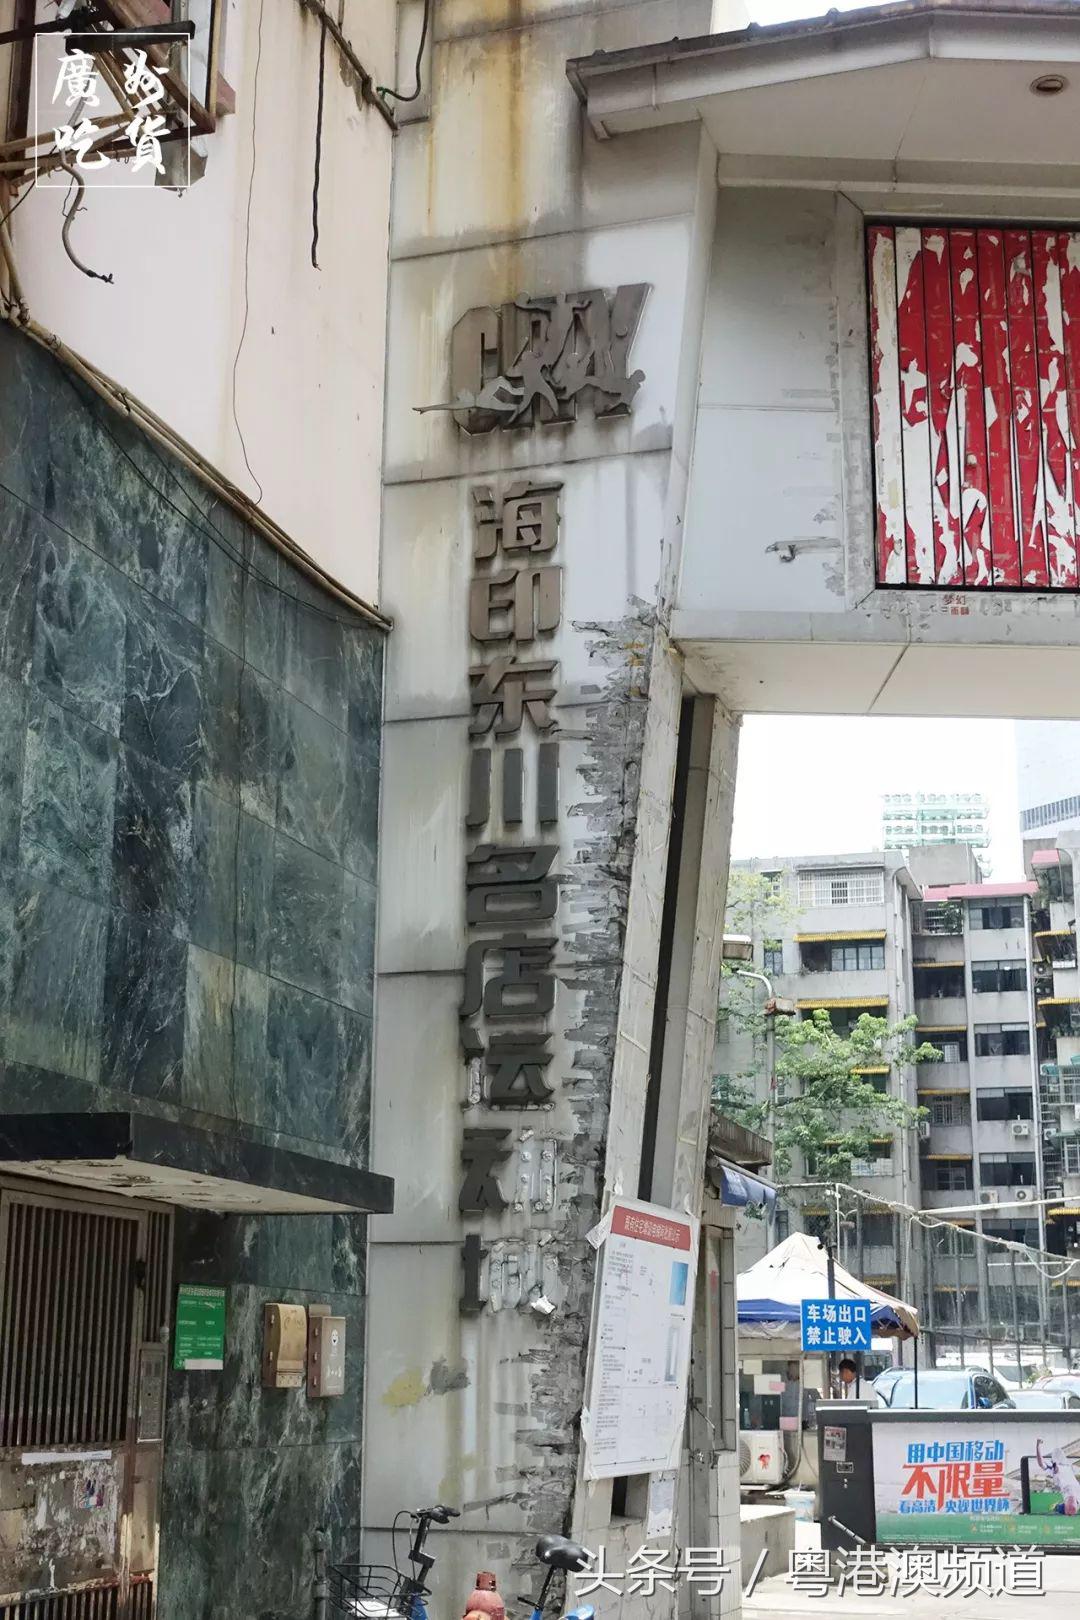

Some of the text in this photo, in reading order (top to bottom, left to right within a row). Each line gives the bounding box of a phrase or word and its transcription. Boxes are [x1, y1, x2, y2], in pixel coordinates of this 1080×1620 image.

[807, 1303, 866, 1323] 车场出口
[807, 1326, 867, 1345] 禁止驶入
[908, 1440, 1004, 1463] 用中国移动
[901, 1462, 1010, 1511] 不限量
